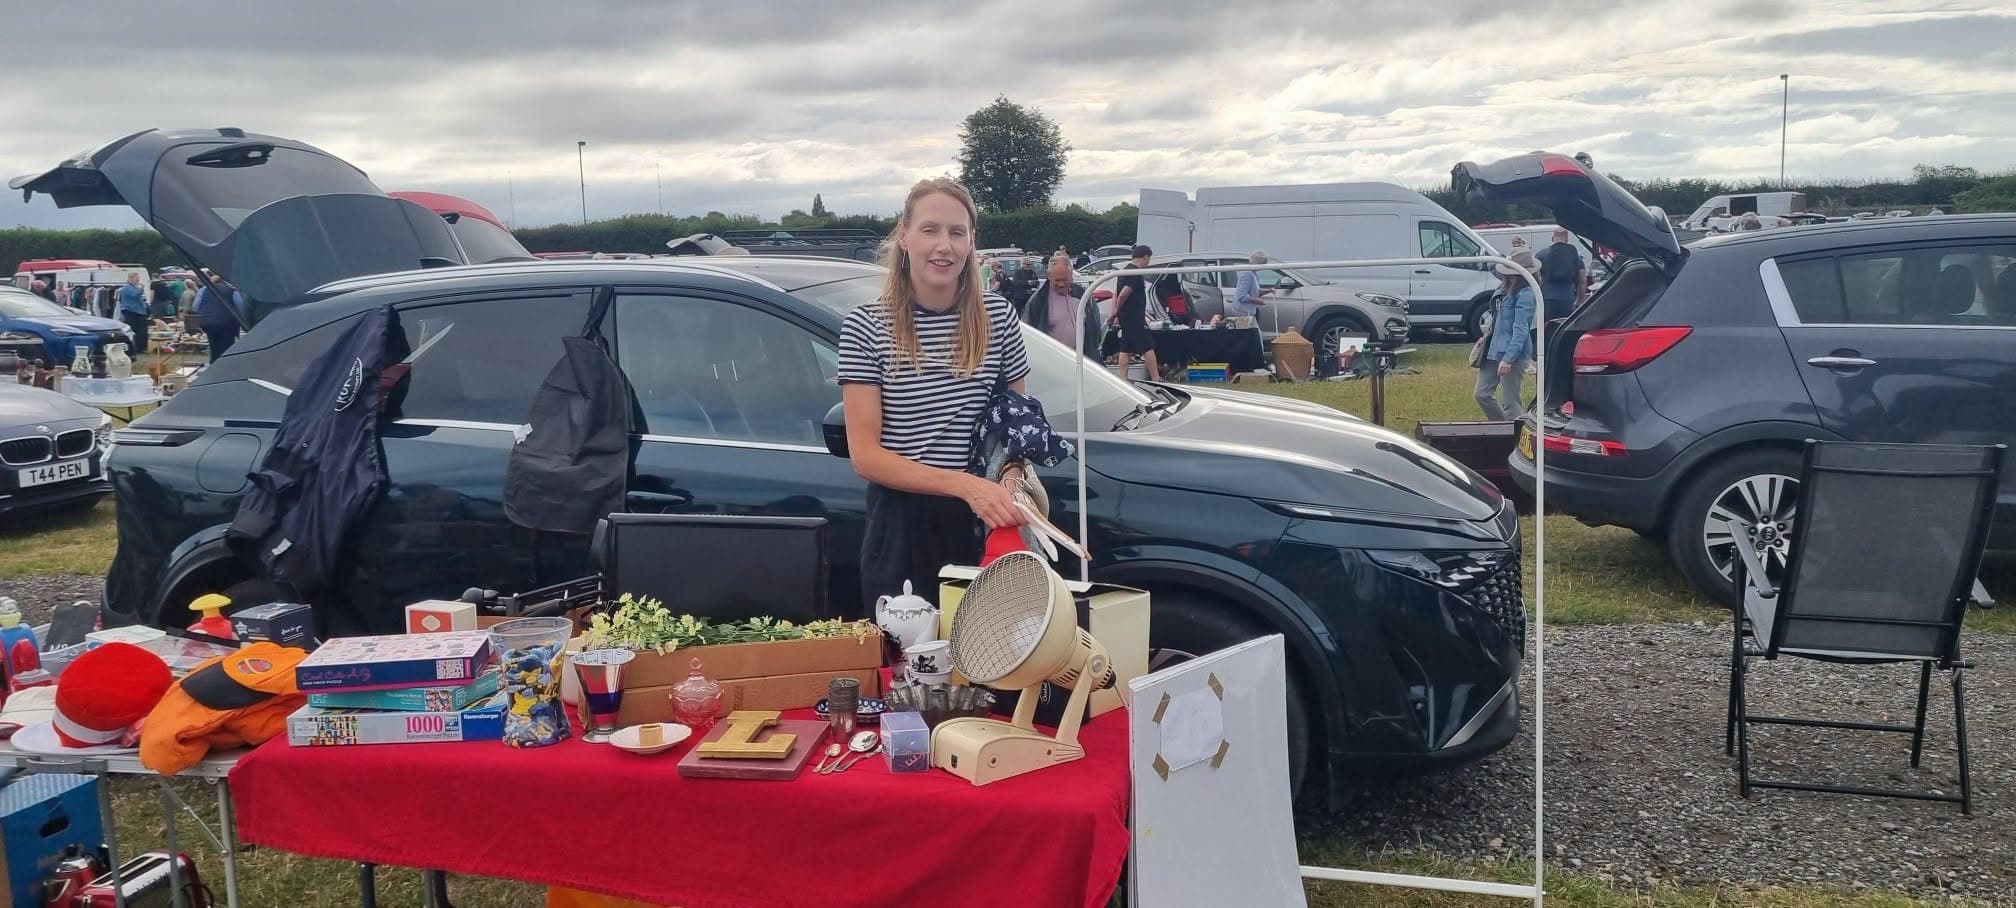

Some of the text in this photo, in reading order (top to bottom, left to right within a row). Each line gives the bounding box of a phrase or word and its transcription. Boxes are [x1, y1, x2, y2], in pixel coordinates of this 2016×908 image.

[29, 462, 82, 483] T44 PEN
[405, 715, 443, 734] 1000
